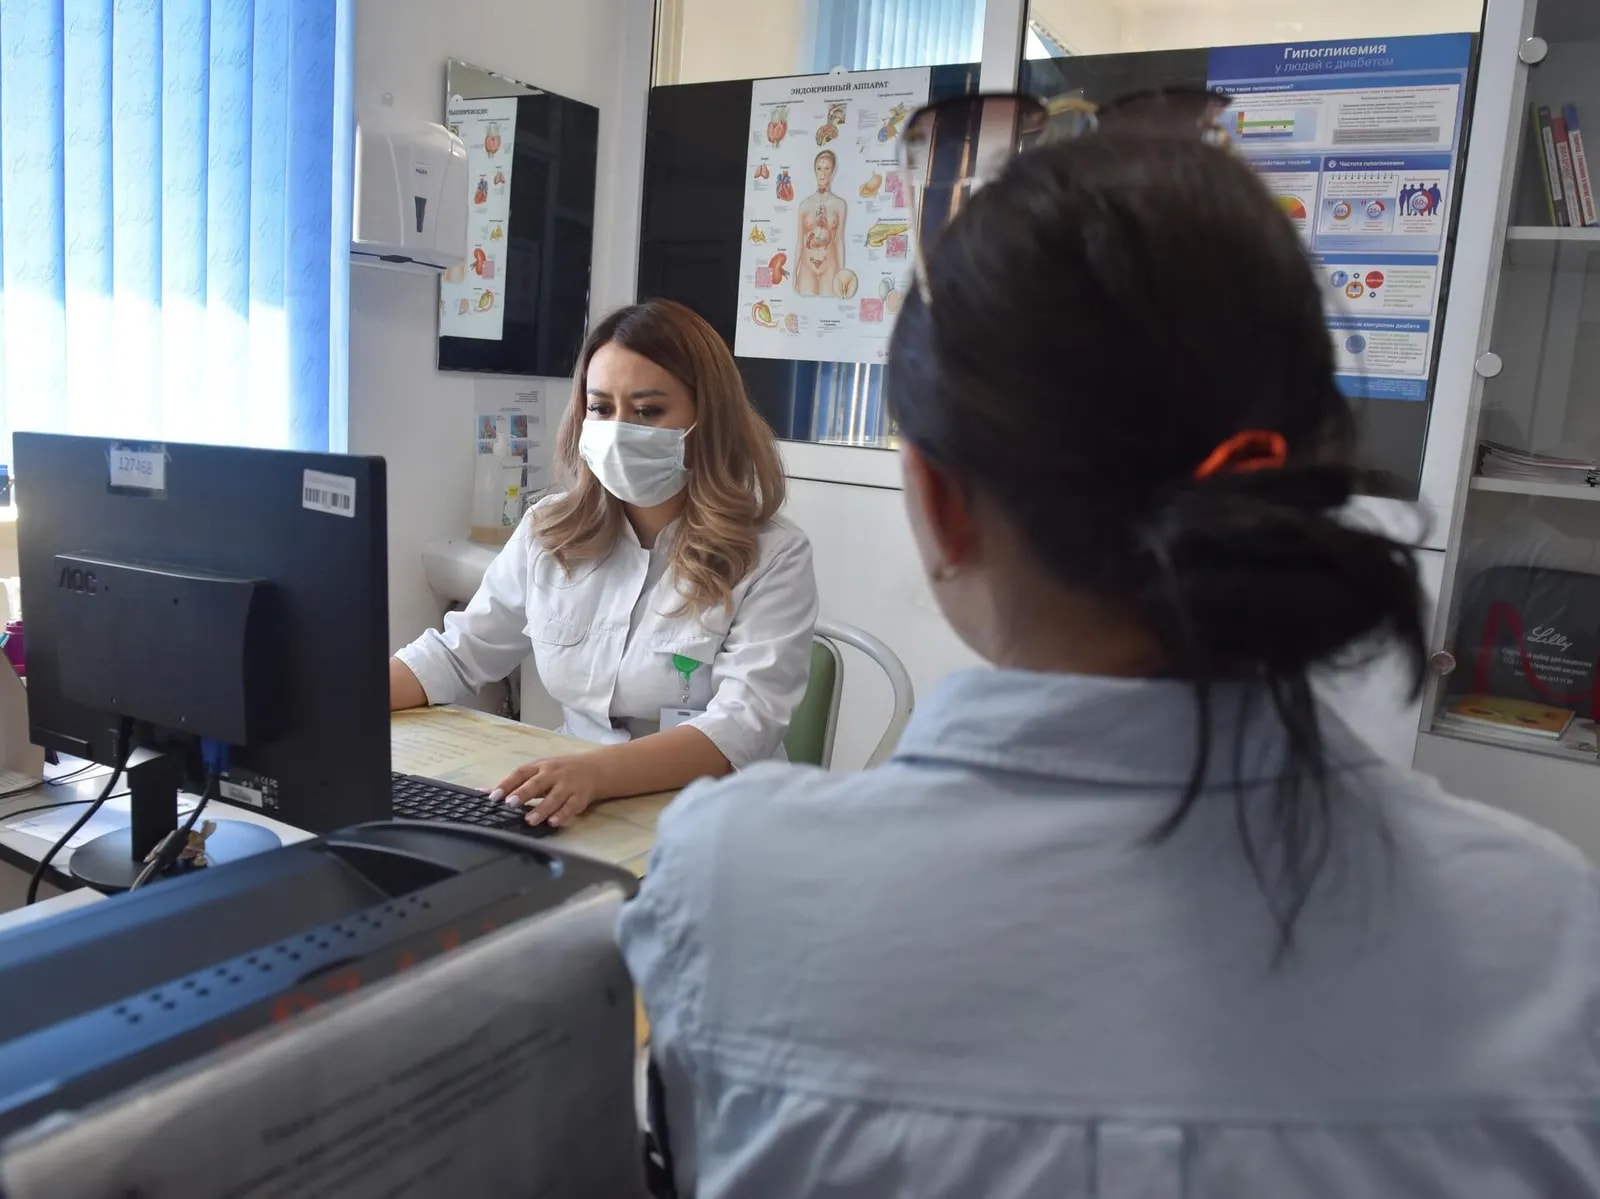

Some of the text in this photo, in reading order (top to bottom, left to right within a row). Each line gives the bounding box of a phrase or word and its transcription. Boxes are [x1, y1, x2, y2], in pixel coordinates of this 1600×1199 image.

[1283, 44, 1387, 60] Гипогликемия
[1274, 57, 1395, 74] у людей с диабетом
[790, 80, 889, 96] ЭНДОКРИННЫЙ АППАРАТ
[1527, 625, 1574, 652] Lilly
